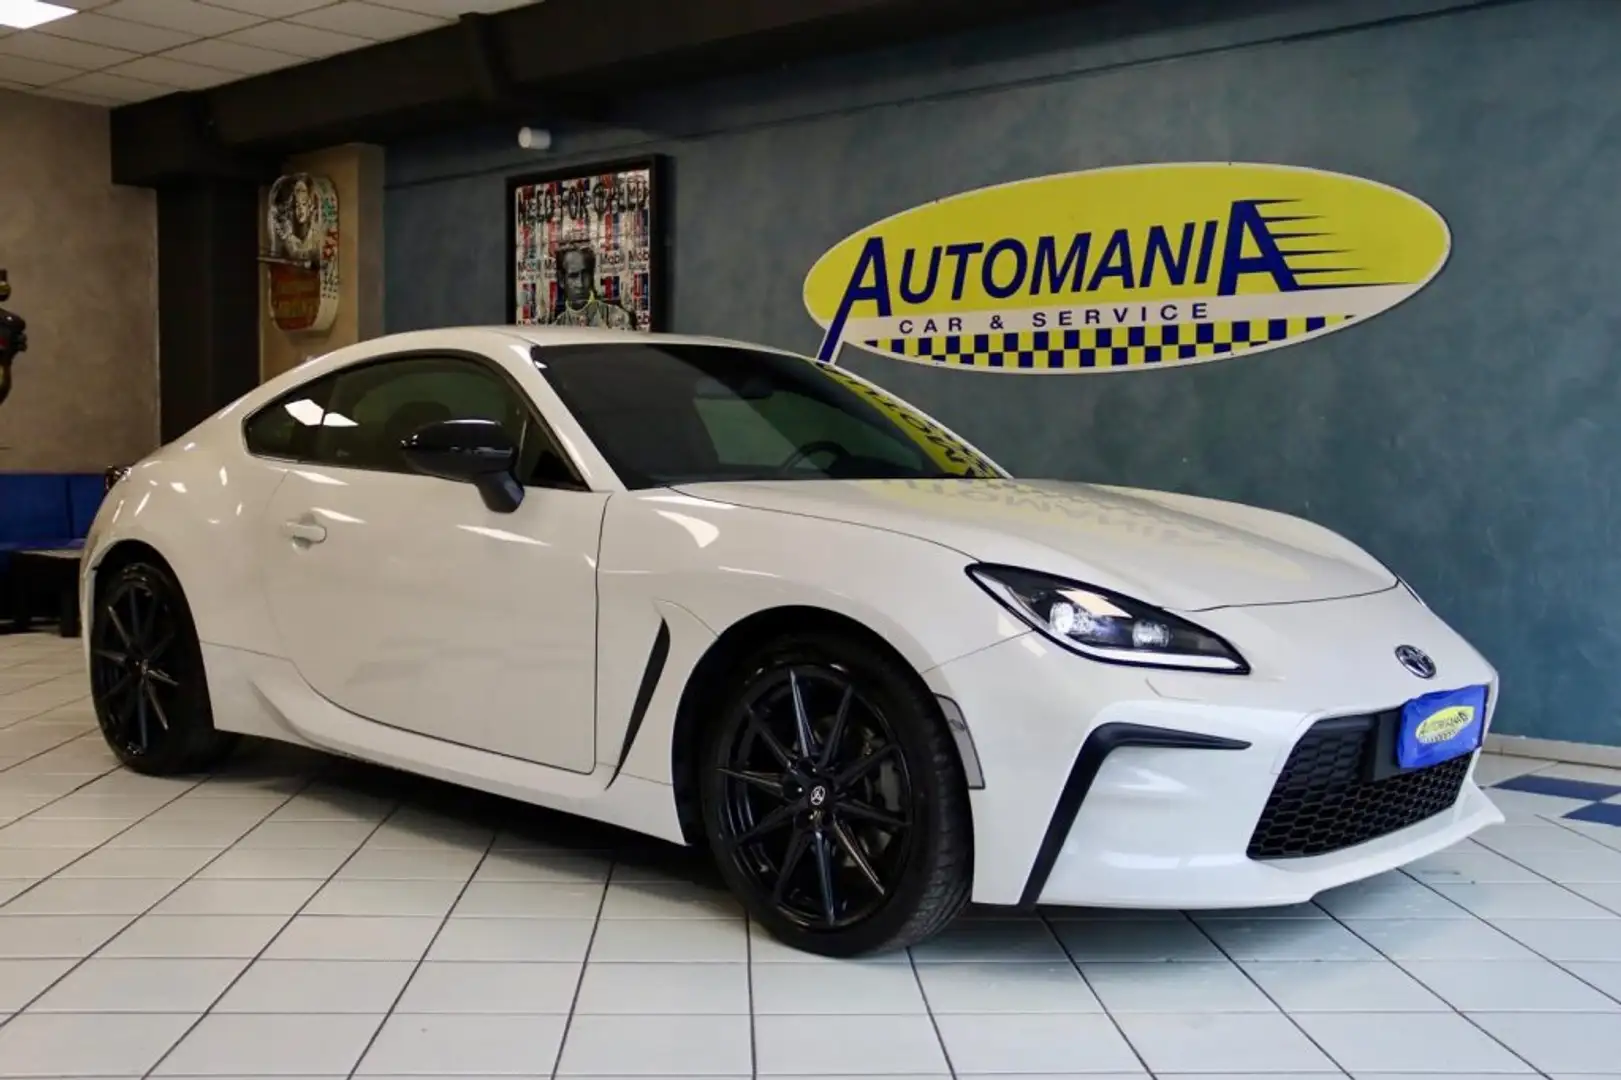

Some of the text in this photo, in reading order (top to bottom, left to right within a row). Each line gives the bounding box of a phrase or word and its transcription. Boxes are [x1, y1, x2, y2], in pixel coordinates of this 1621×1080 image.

[817, 199, 1301, 362] AUTOMANIA
[899, 302, 1208, 334] CAR & SERVICE
